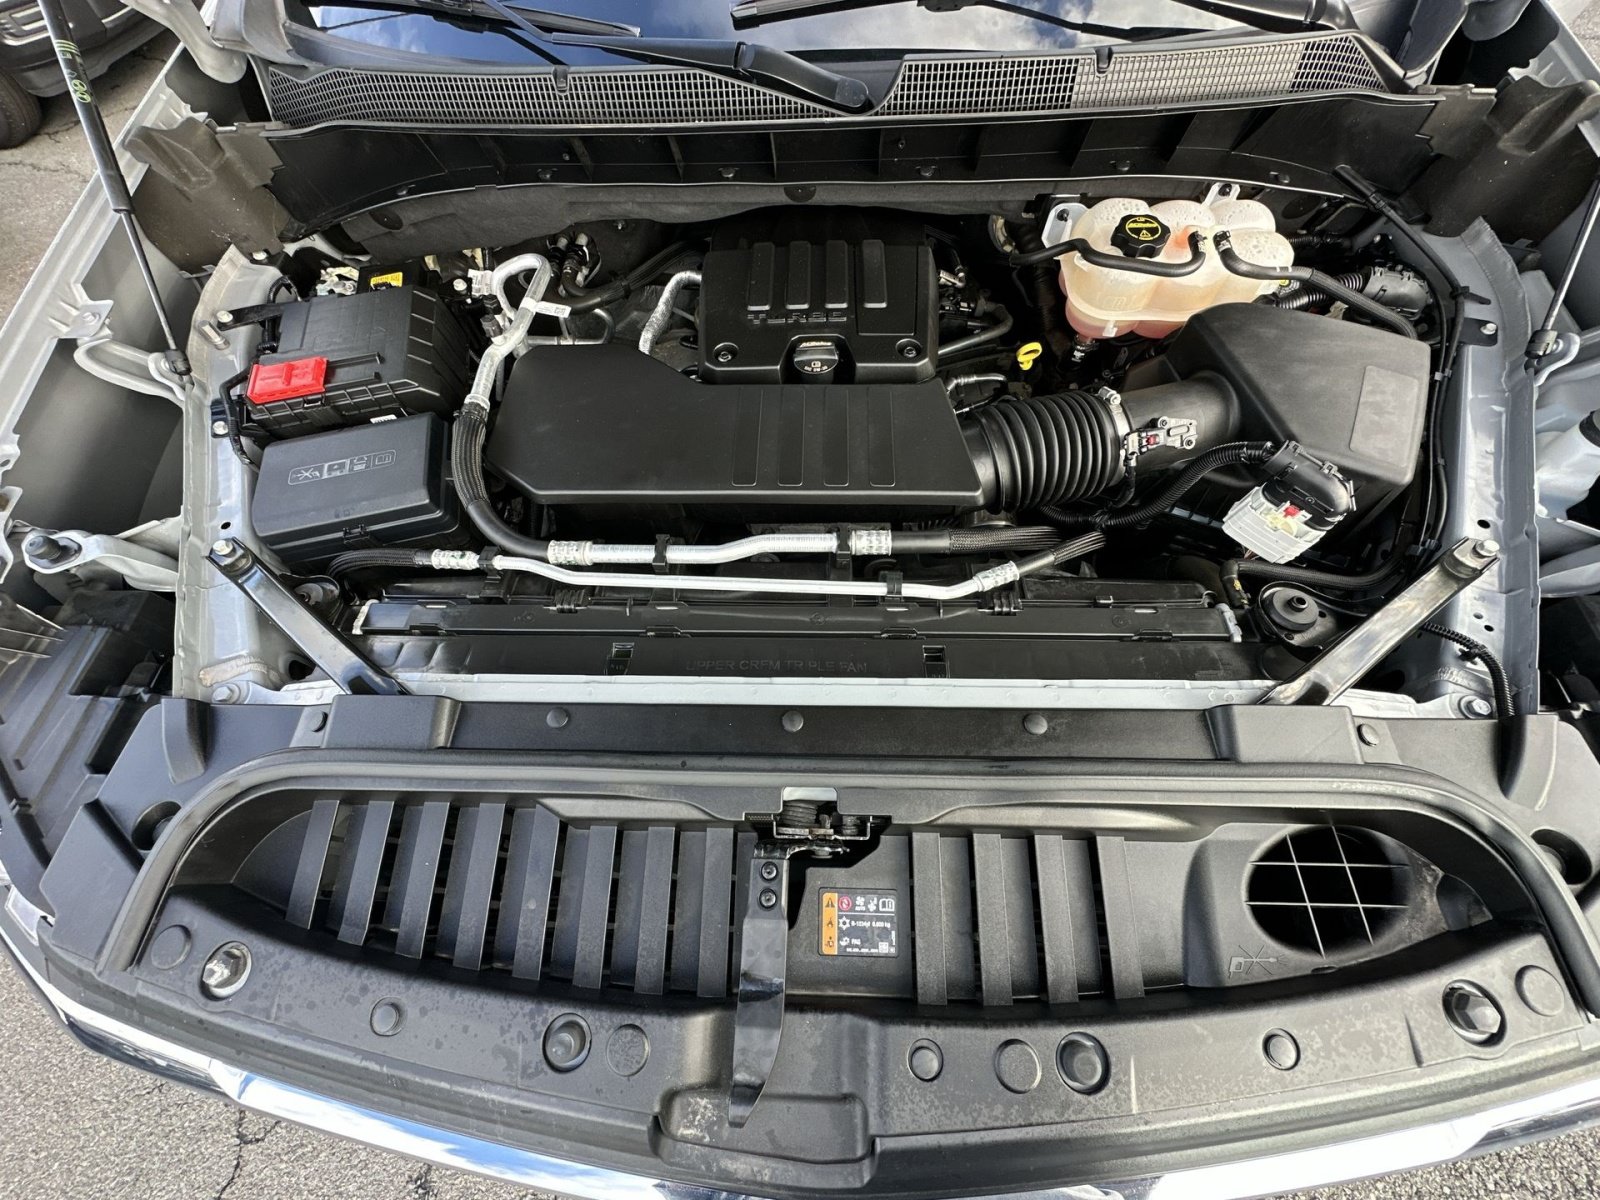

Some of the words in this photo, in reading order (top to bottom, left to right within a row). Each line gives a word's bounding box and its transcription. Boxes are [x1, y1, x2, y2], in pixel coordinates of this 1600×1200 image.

[686, 659, 735, 671] UPPER
[784, 660, 835, 672] TRPLE
[839, 660, 867, 673] FAN
